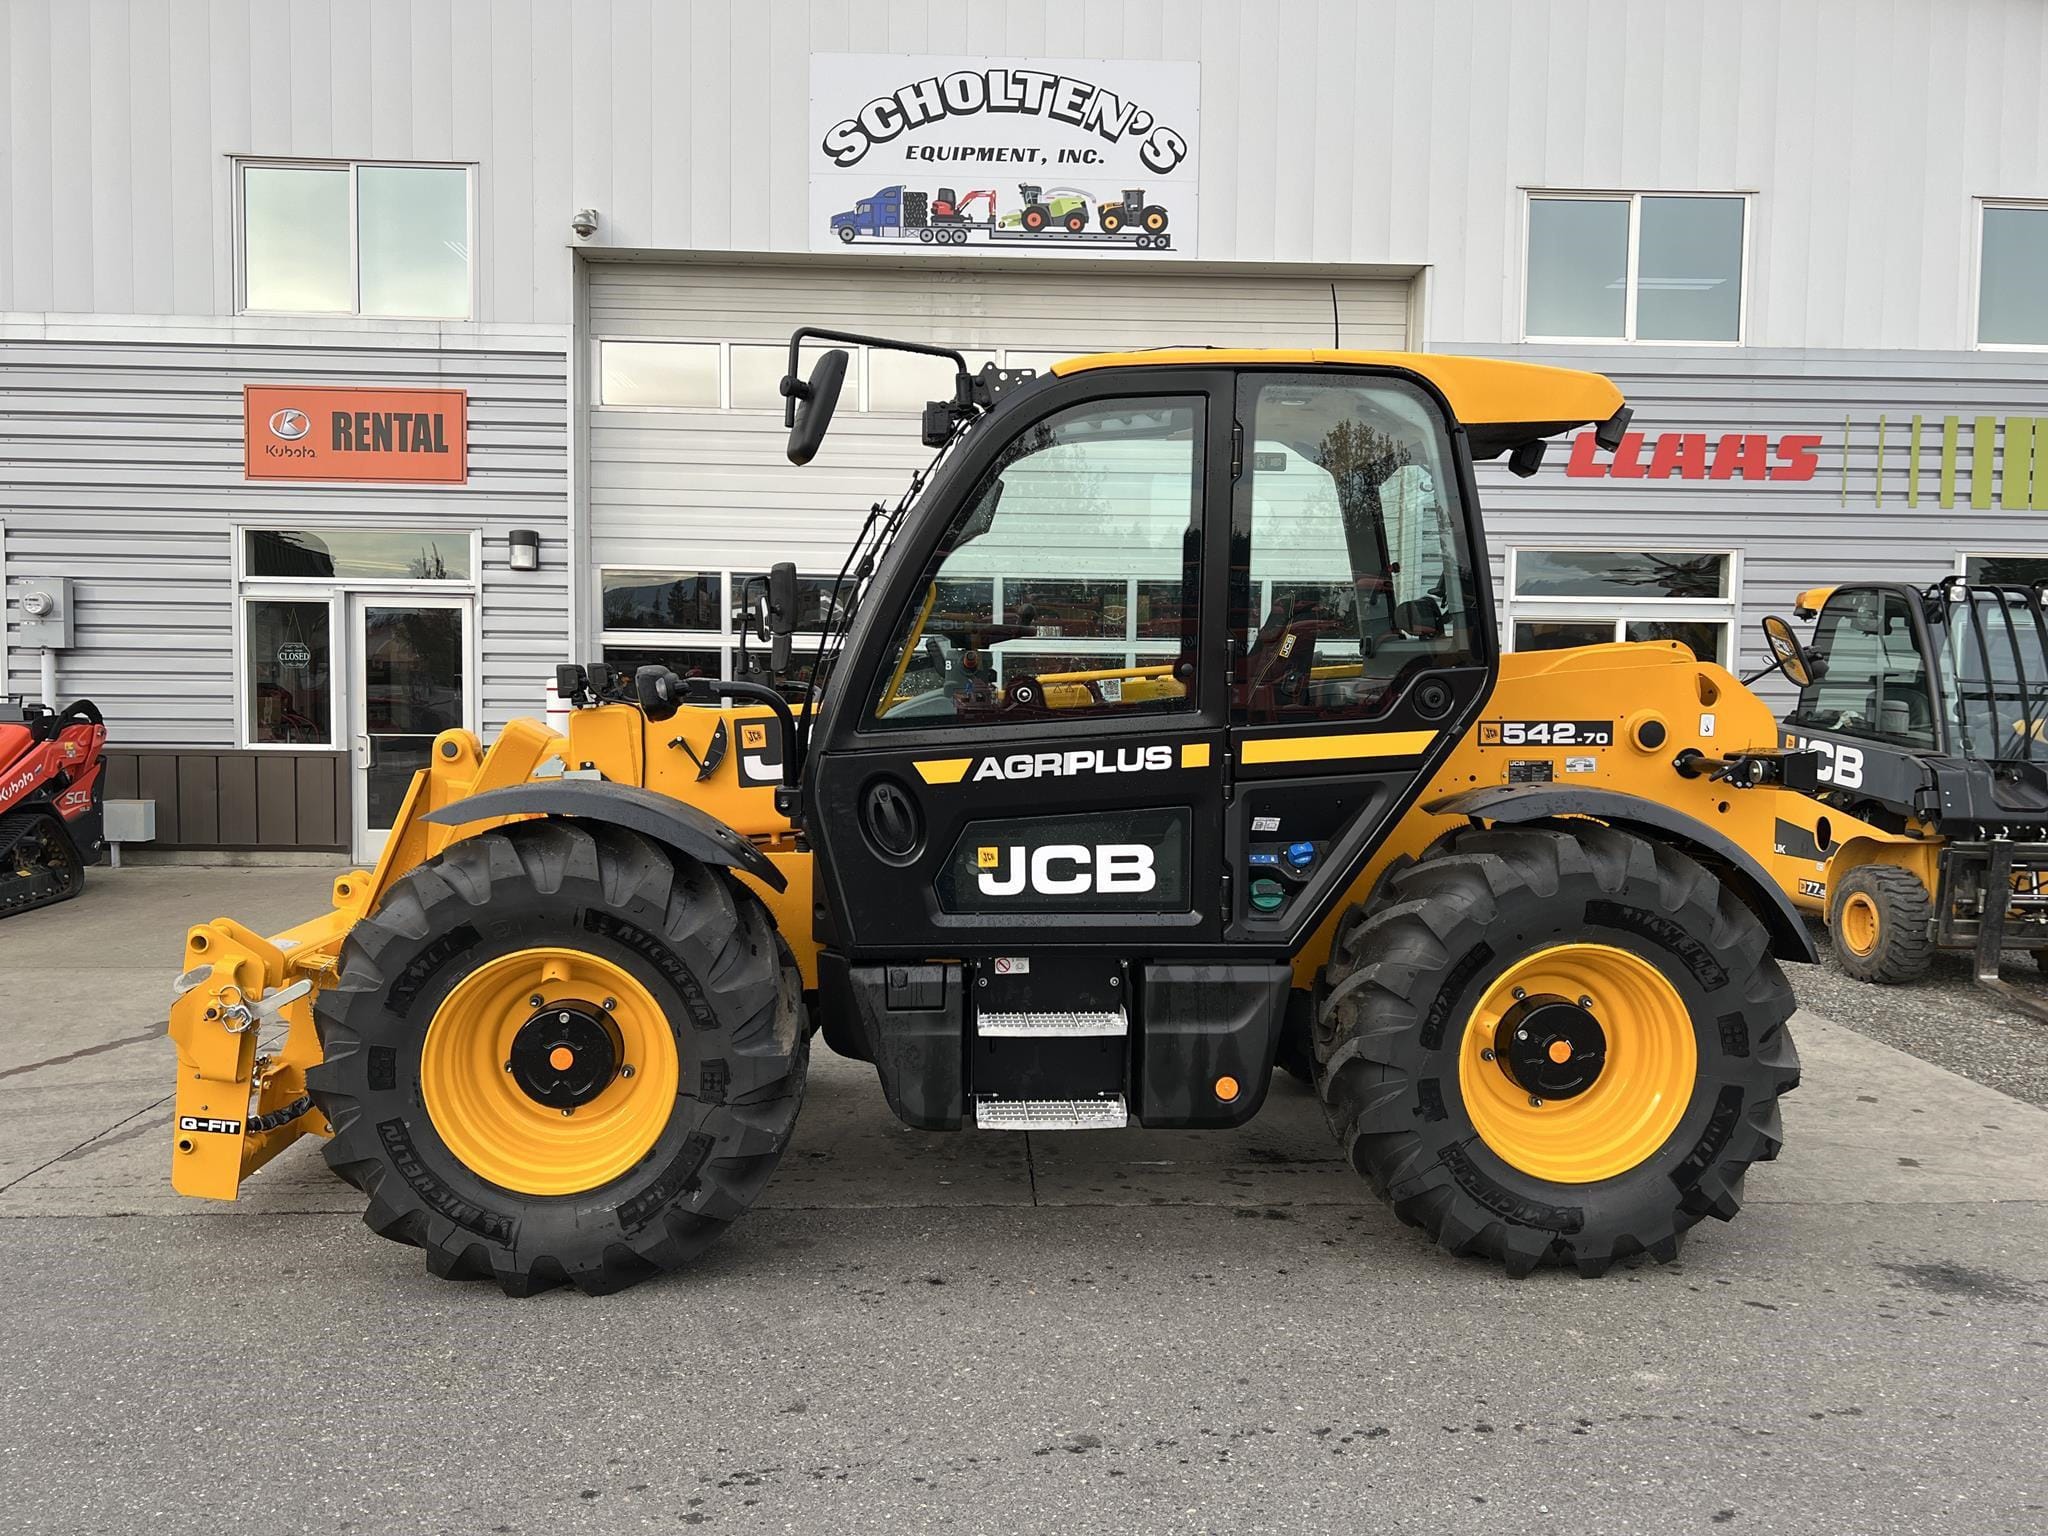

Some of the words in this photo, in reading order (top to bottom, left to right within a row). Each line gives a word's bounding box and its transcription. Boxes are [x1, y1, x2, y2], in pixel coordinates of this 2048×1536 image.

[822, 69, 1187, 175] SCHOLTEN'S
[905, 145, 1047, 166] EQUIPMENT,
[1057, 149, 1104, 165] INC.
[332, 411, 449, 453] RENTAL
[265, 445, 316, 458] Kubota
[1566, 432, 1823, 480] CLAAS
[279, 652, 310, 661] CLOSED
[1502, 723, 1608, 744] 542-70
[972, 746, 1172, 781] AGRIPLUS
[0, 772, 34, 801] Kubota
[65, 789, 91, 805] SCL
[978, 844, 1156, 896] JCB
[616, 924, 714, 1027] MICHELIN
[381, 1123, 479, 1233] MICHELIN
